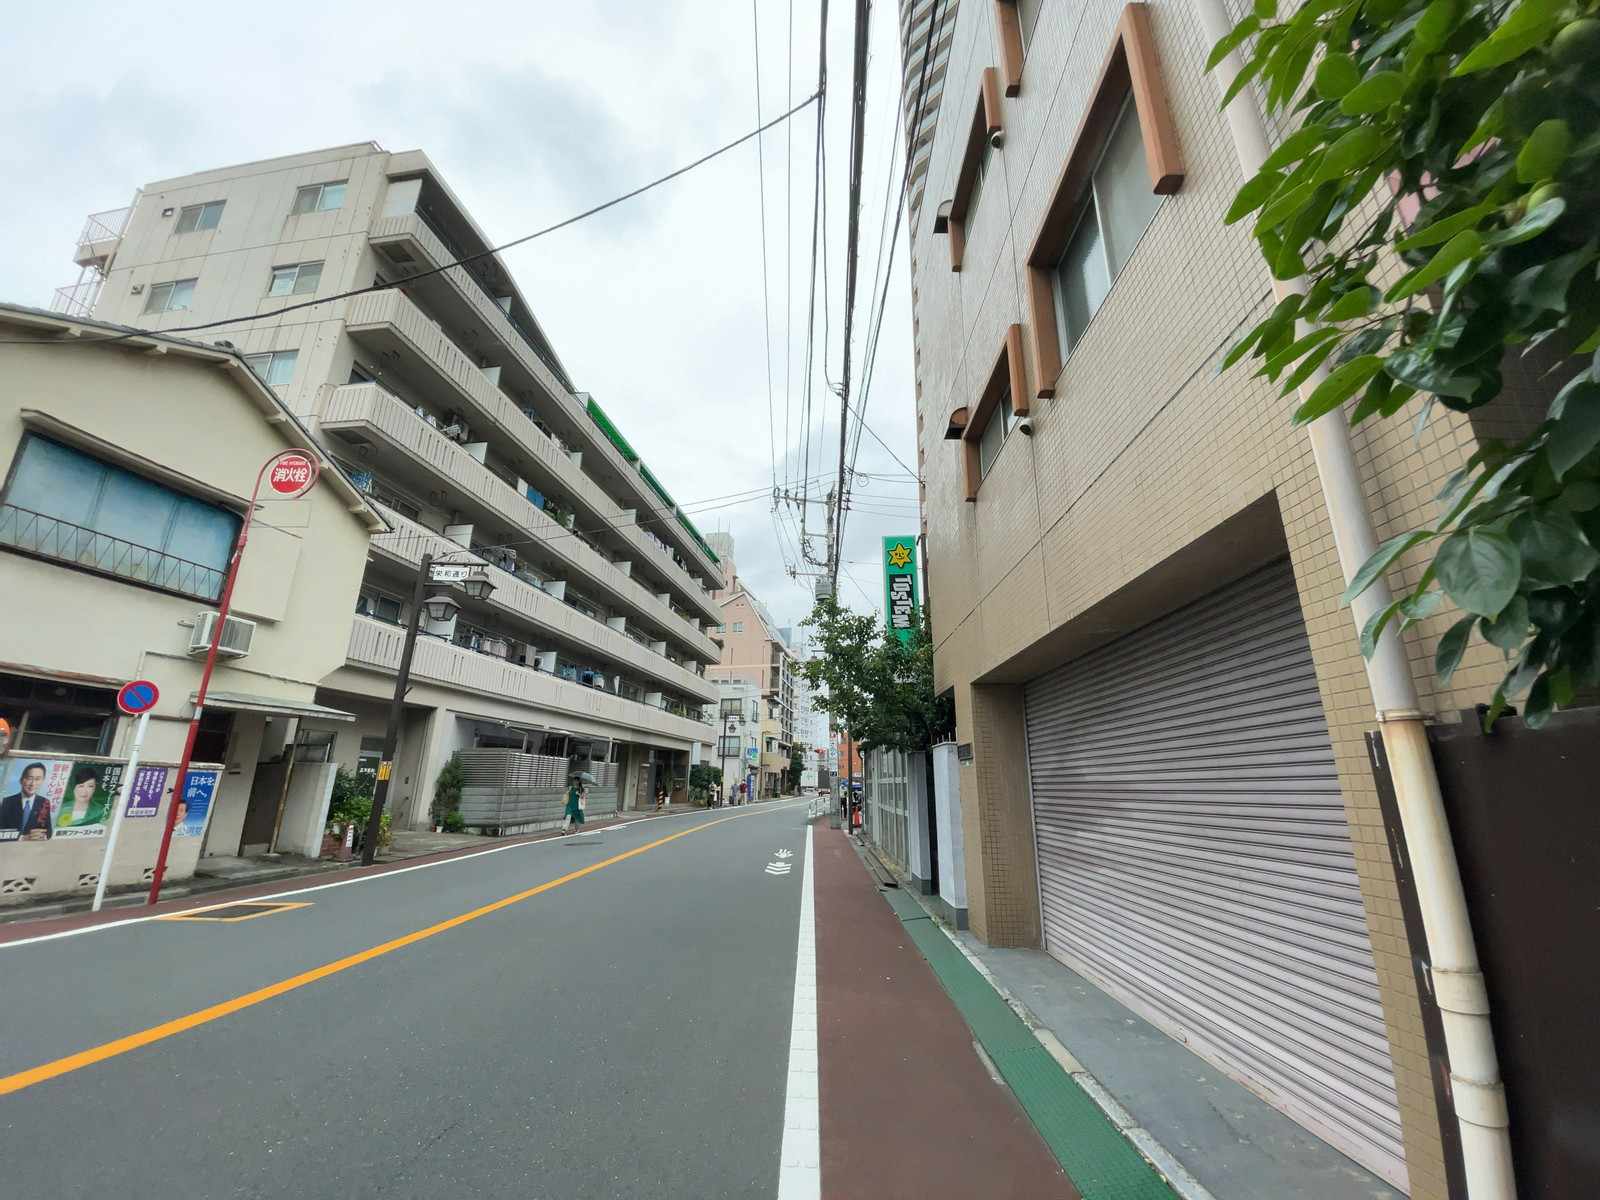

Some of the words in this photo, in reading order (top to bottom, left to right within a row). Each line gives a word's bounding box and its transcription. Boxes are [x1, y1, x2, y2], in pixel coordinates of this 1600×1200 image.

[273, 467, 308, 483] 消火栓
[435, 570, 467, 578] 栄和通り
[890, 574, 914, 628] TOSTEM
[190, 775, 215, 786] 日本を、
[50, 764, 70, 812] 新しい時代を
[187, 787, 208, 798] 前へ。
[56, 829, 104, 837] 都民ファーストの会
[176, 826, 203, 836] 公明党
